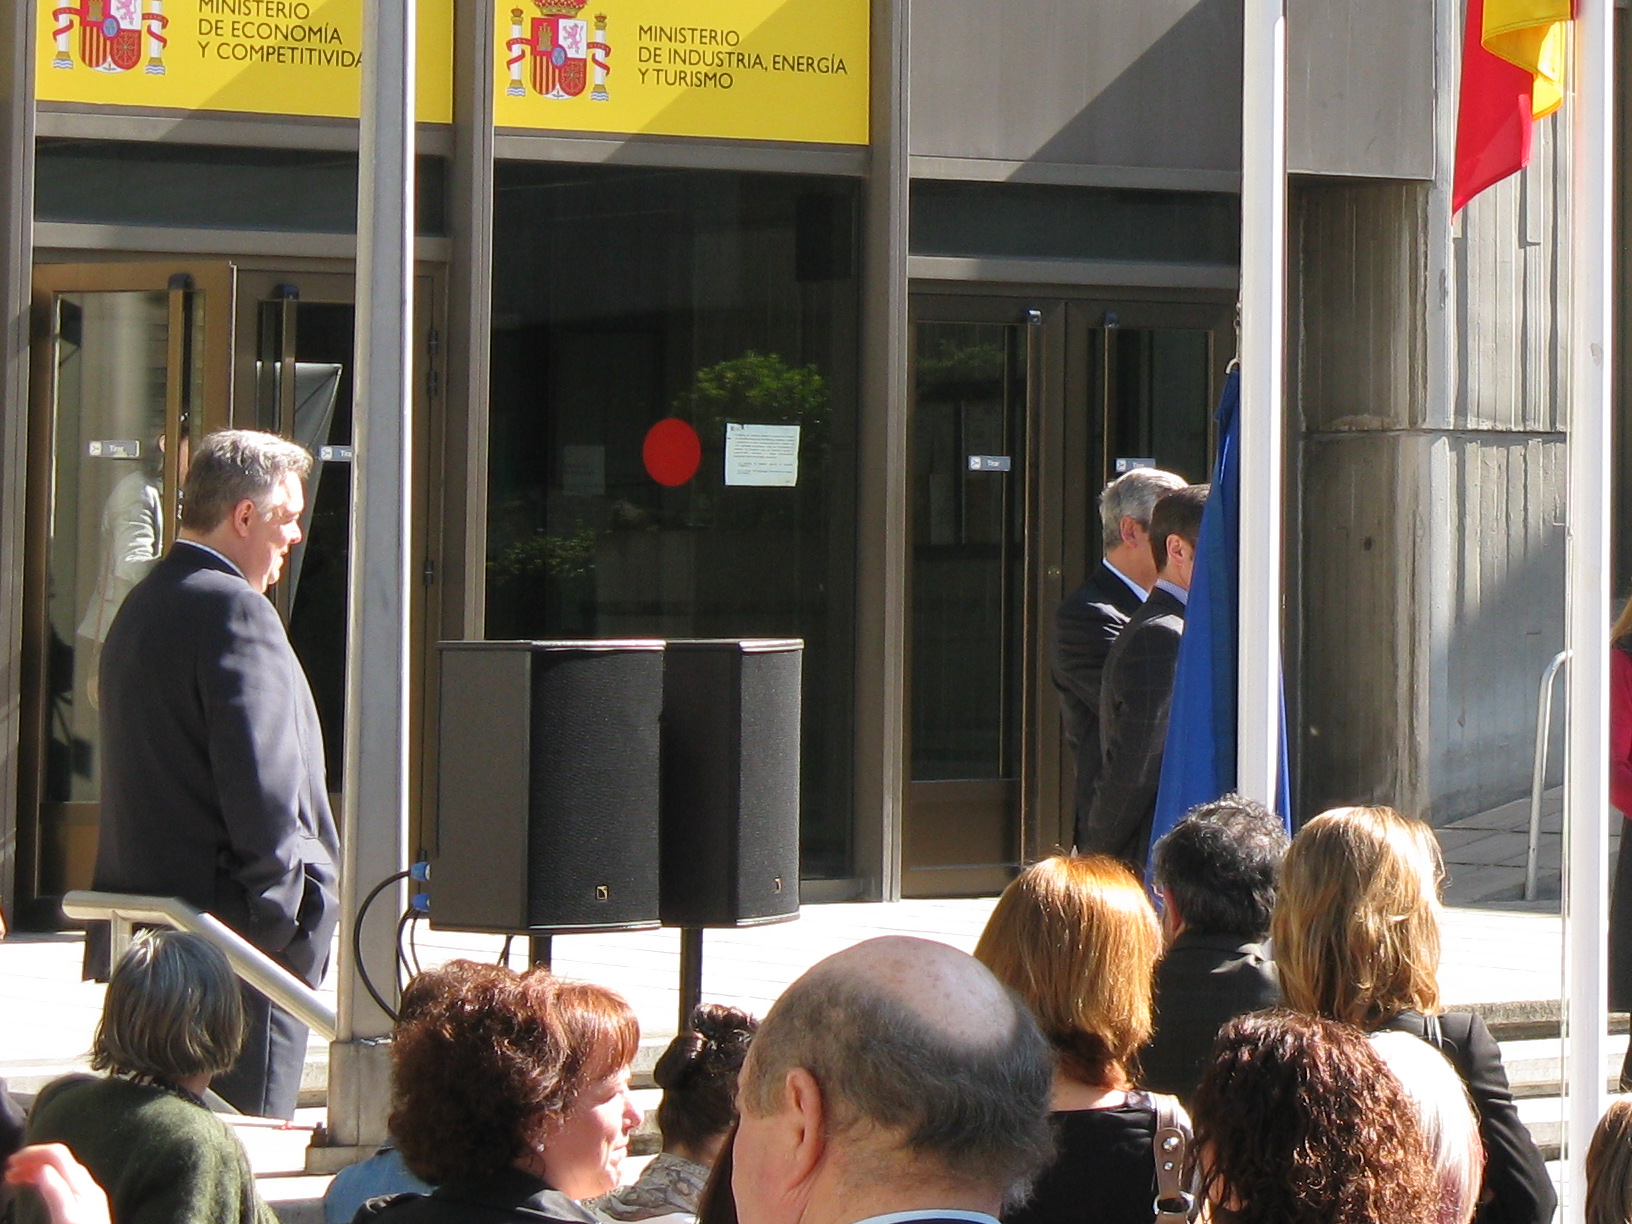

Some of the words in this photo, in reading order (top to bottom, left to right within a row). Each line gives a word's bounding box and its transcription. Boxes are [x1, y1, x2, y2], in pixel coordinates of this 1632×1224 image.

[199, 18, 224, 37] DE
[231, 21, 343, 45] ECONOMÍA
[638, 24, 740, 47] MINISTERIO
[197, 40, 210, 58] Y
[216, 41, 363, 68] COMPETITIVIDA
[638, 46, 662, 63] DE
[668, 47, 768, 72] INDUSTRIA,
[772, 53, 848, 75] ENERGÍA
[638, 67, 650, 85] Y
[652, 68, 734, 90] TURISMO
